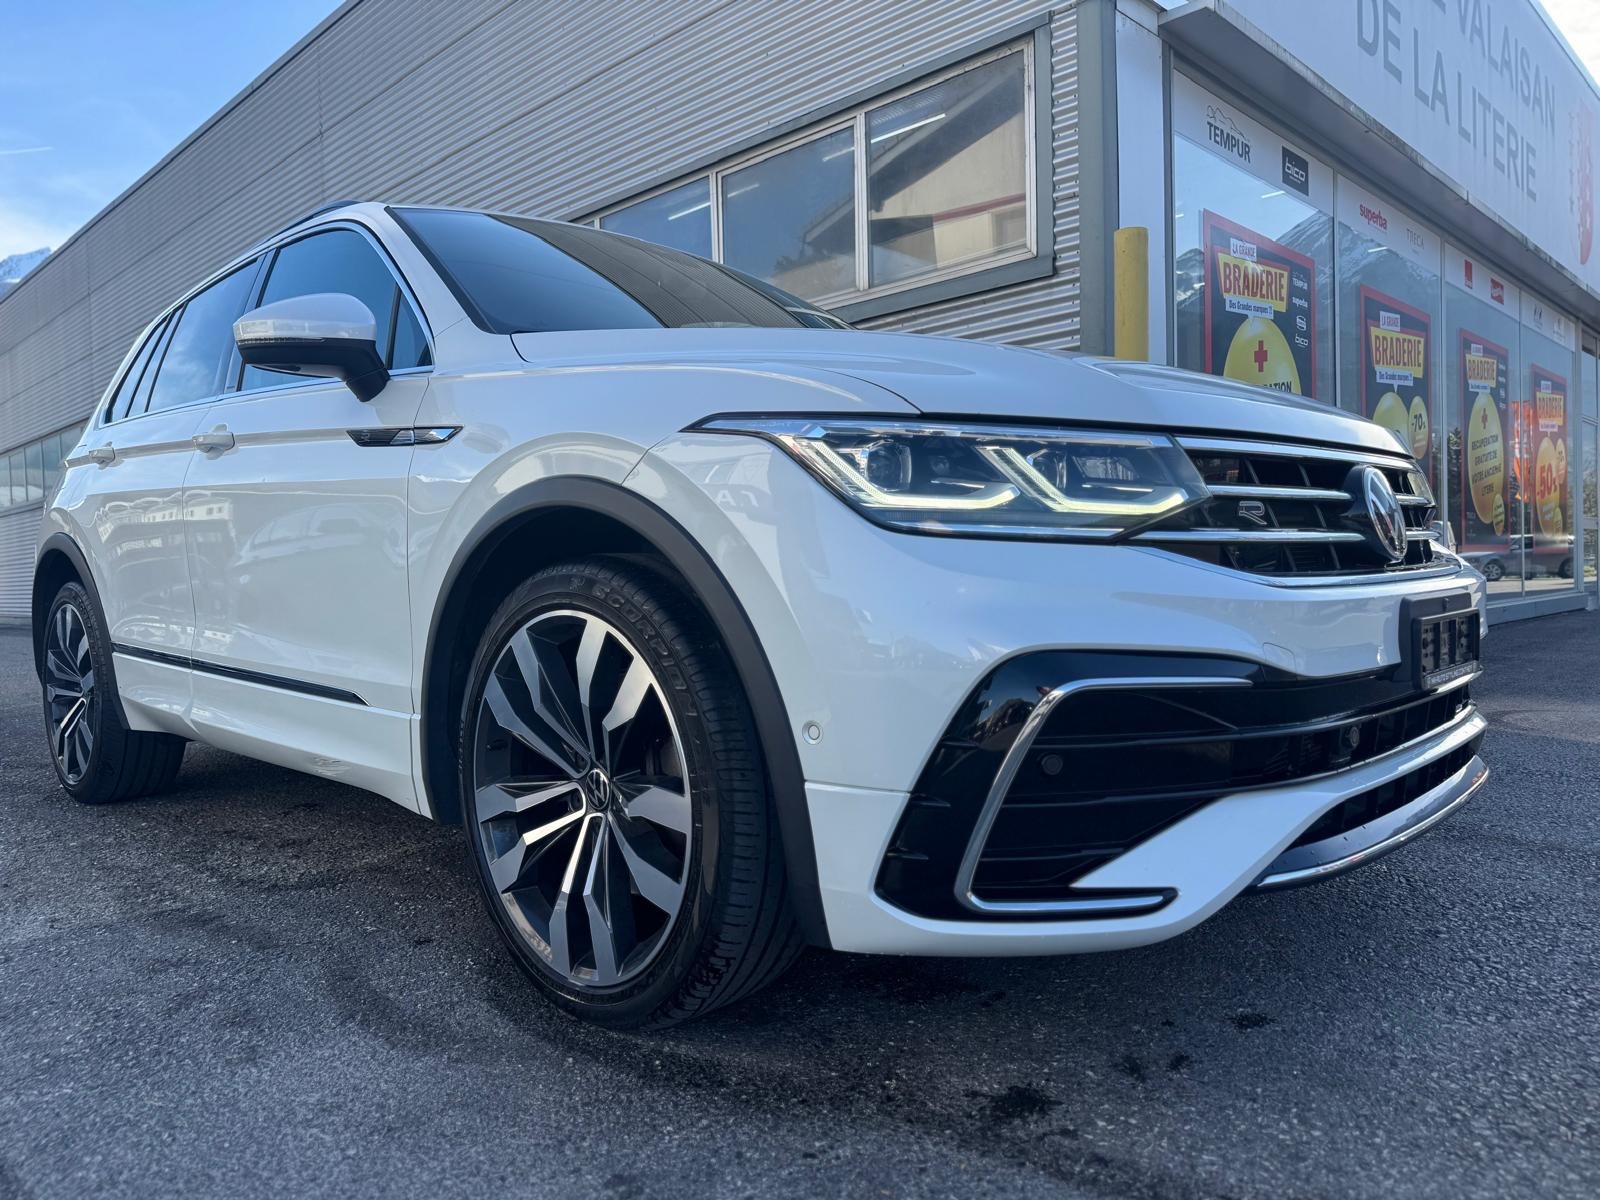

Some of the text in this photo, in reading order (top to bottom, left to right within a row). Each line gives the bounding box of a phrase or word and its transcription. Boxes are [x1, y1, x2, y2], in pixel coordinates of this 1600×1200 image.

[1457, 0, 1555, 136] VALAISAN
[1357, 0, 1537, 203] DE LA LITERIE
[1207, 121, 1251, 163] TEMPUR
[1285, 157, 1306, 182] bico
[1360, 204, 1387, 230] superba
[1223, 262, 1285, 302] BRADERIE
[1375, 334, 1422, 368] BRADERIE
